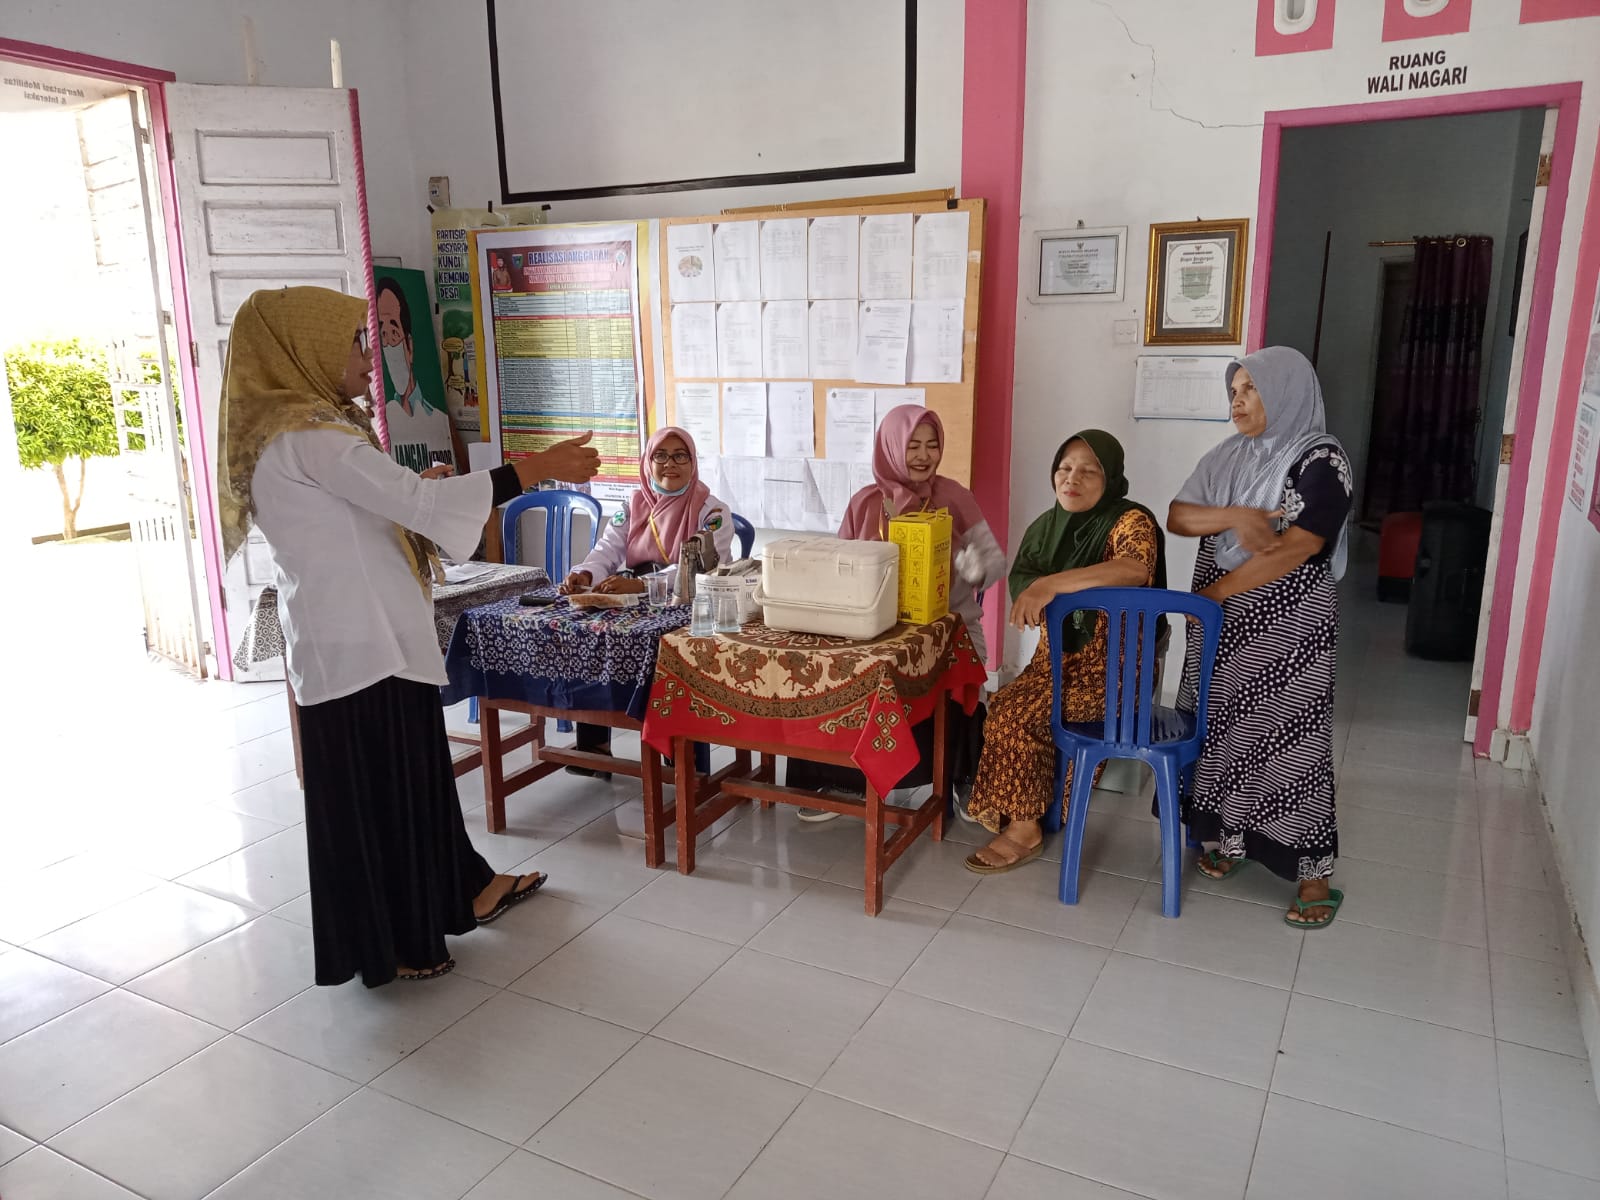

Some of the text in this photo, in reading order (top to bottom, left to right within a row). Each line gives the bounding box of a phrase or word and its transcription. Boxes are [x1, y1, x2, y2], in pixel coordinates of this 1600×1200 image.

[1389, 50, 1446, 71] RUANG
[1367, 66, 1467, 94] WALI NAGARI
[438, 255, 462, 268] KUNCI
[440, 287, 459, 299] DESA
